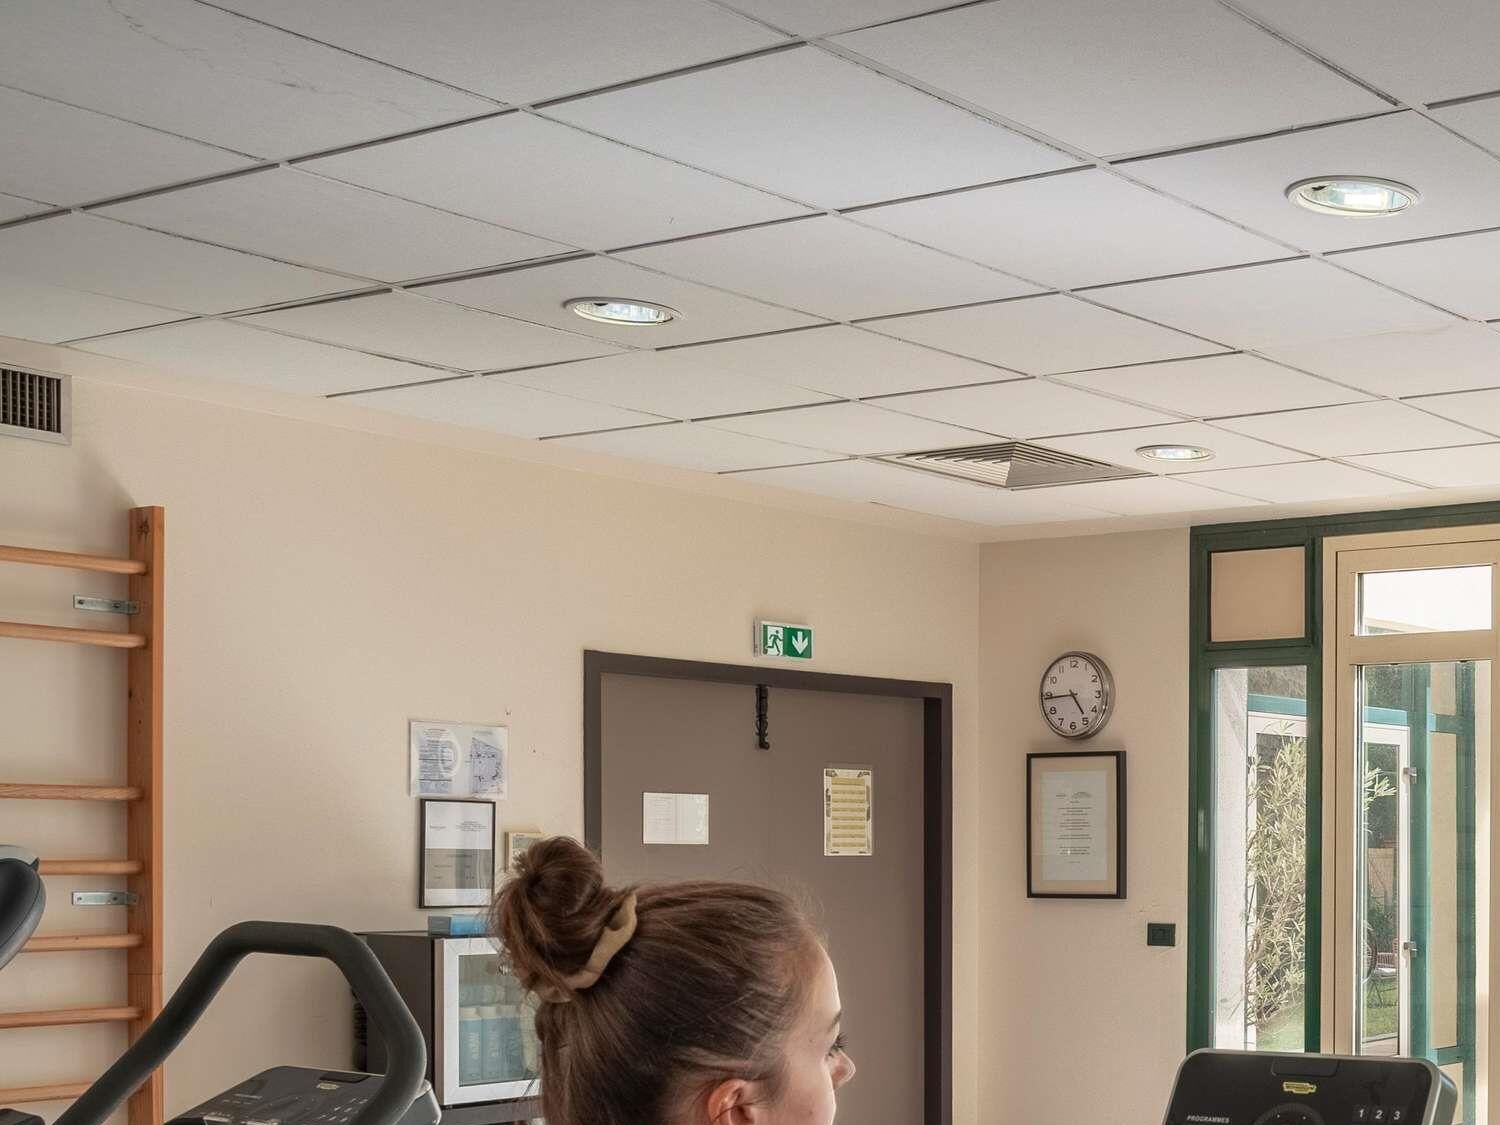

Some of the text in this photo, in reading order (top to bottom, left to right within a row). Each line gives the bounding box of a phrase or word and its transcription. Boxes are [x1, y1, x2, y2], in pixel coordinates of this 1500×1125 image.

[1070, 660, 1079, 669] 12
[1095, 690, 1101, 698] 3
[1049, 706, 1057, 715] 8
[1091, 705, 1097, 713] 4
[1058, 718, 1064, 726] 7
[1082, 717, 1089, 725] 5
[1069, 722, 1077, 730] 6
[1359, 1108, 1400, 1120] 1 2 3
